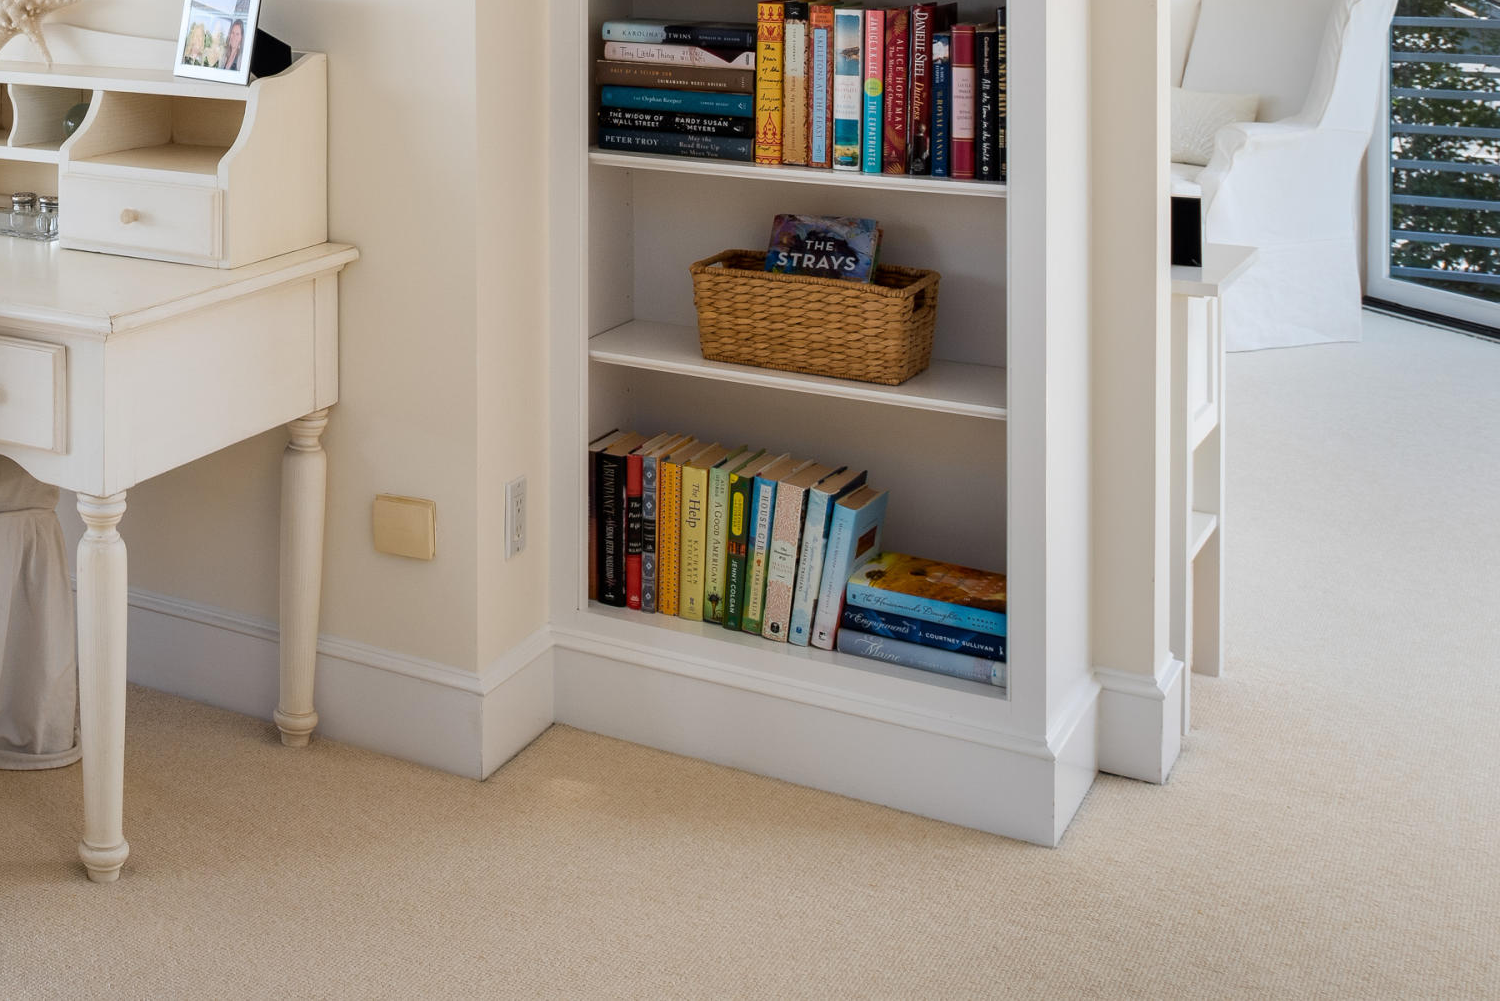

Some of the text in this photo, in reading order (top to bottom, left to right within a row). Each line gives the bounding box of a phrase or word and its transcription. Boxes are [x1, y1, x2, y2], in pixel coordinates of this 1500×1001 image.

[870, 17, 878, 44] JANICE
[620, 46, 675, 61] Tiny Little Thing
[915, 12, 929, 76] DANIELLE STEEL
[870, 62, 878, 74] LEE
[816, 84, 823, 93] AT
[895, 38, 904, 130] ALICE HOFFMAN
[982, 78, 991, 90] All
[914, 81, 925, 120] Duchess
[983, 104, 991, 119] Time
[612, 118, 632, 126] WALL
[687, 125, 716, 133] MEYERS
[703, 119, 729, 127] SUSAN
[983, 121, 989, 129] in
[605, 135, 660, 146] PETER TROY
[868, 101, 877, 166] THE EXPATRIATES
[983, 131, 991, 141] the
[983, 142, 991, 161] World
[805, 240, 835, 252] THE
[776, 252, 857, 271] STRAYS
[686, 483, 701, 528] The Help
[713, 510, 722, 536] GOOD
[756, 495, 768, 558] HOUSE GIRL
[605, 540, 613, 554] JETER
[711, 538, 721, 584] AMERICAN
[729, 584, 737, 613] COLGAN
[860, 592, 873, 603] The
[854, 613, 910, 634] Engagements
[854, 638, 901, 662] Maine
[925, 633, 960, 644] COURTNEY
[962, 640, 994, 652] SULLIVAN
